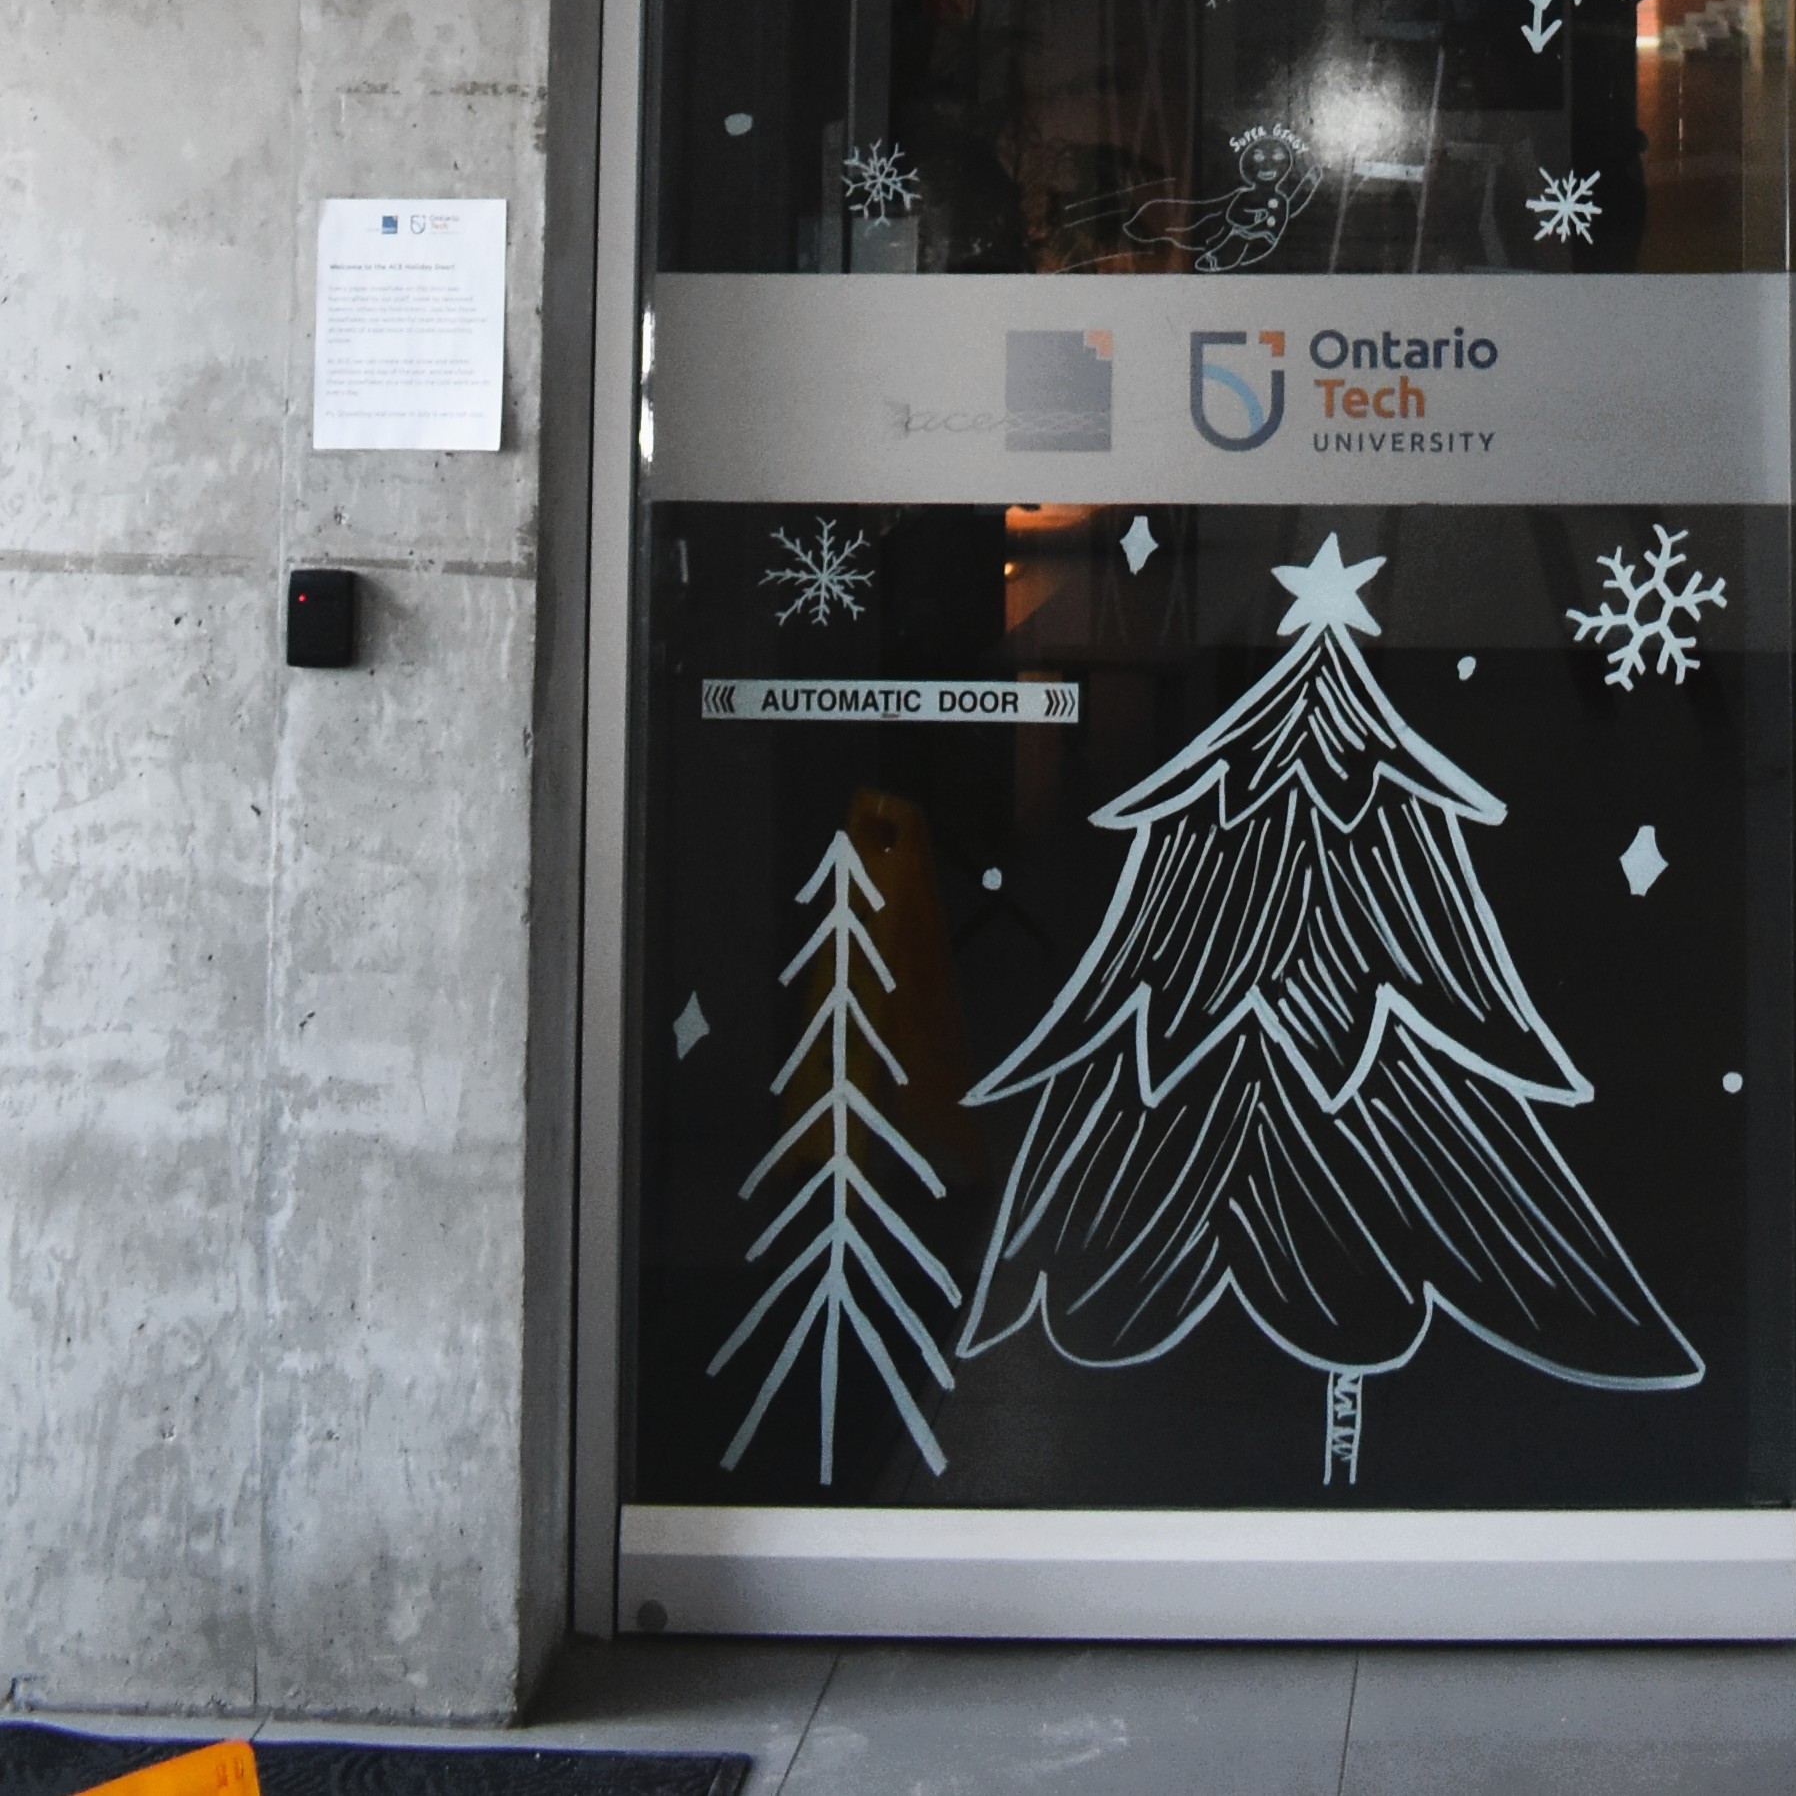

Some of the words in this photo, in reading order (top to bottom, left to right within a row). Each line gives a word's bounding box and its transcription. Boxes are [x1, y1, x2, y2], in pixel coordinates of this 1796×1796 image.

[1309, 326, 1498, 369] Ontario
[1314, 375, 1425, 418] Tech
[1313, 432, 1496, 453] UNIVERSITY
[761, 689, 921, 713] AUTOMATIC
[938, 690, 1019, 713] DOOR
